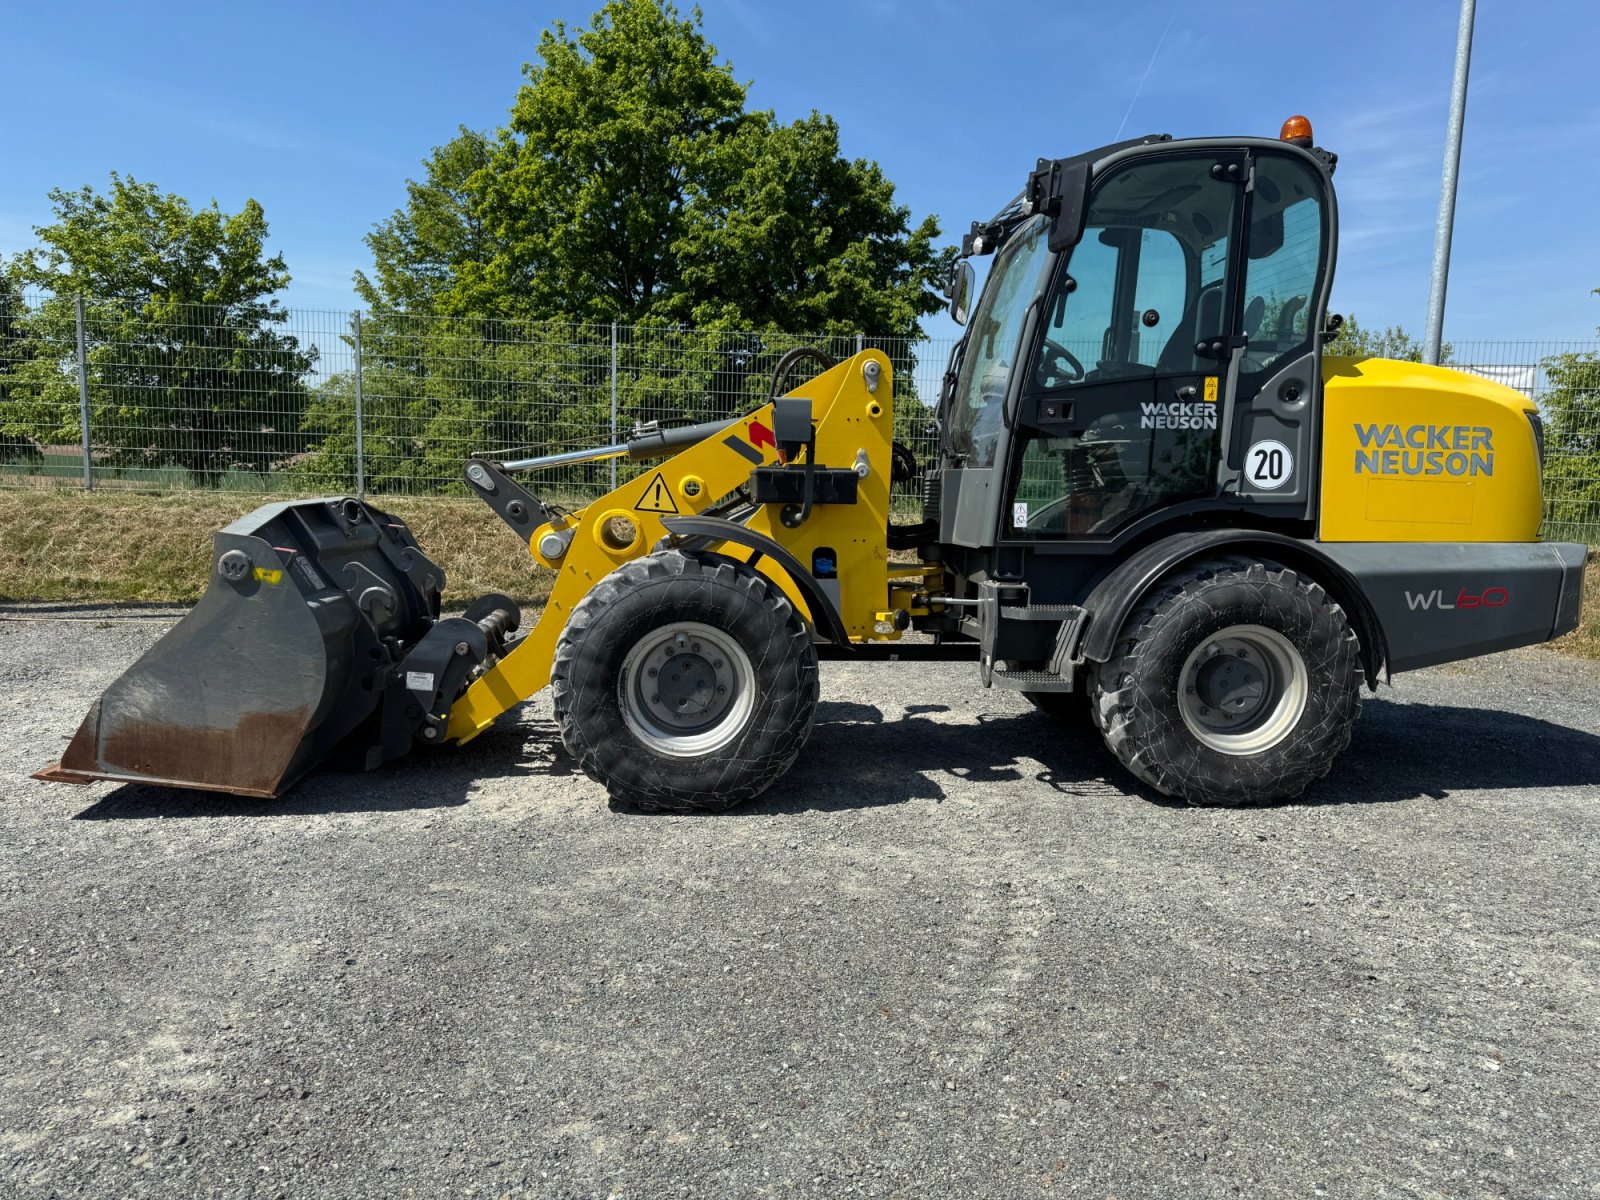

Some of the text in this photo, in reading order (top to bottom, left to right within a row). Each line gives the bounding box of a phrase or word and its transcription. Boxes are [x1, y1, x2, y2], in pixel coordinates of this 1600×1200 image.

[1141, 402, 1217, 417] WACKER
[1141, 415, 1216, 430] NEUSON
[1353, 424, 1494, 450] WACKER
[1254, 449, 1283, 480] 20
[1354, 450, 1494, 476] NEUSON
[223, 561, 246, 577] W
[1405, 587, 1508, 609] WL60
